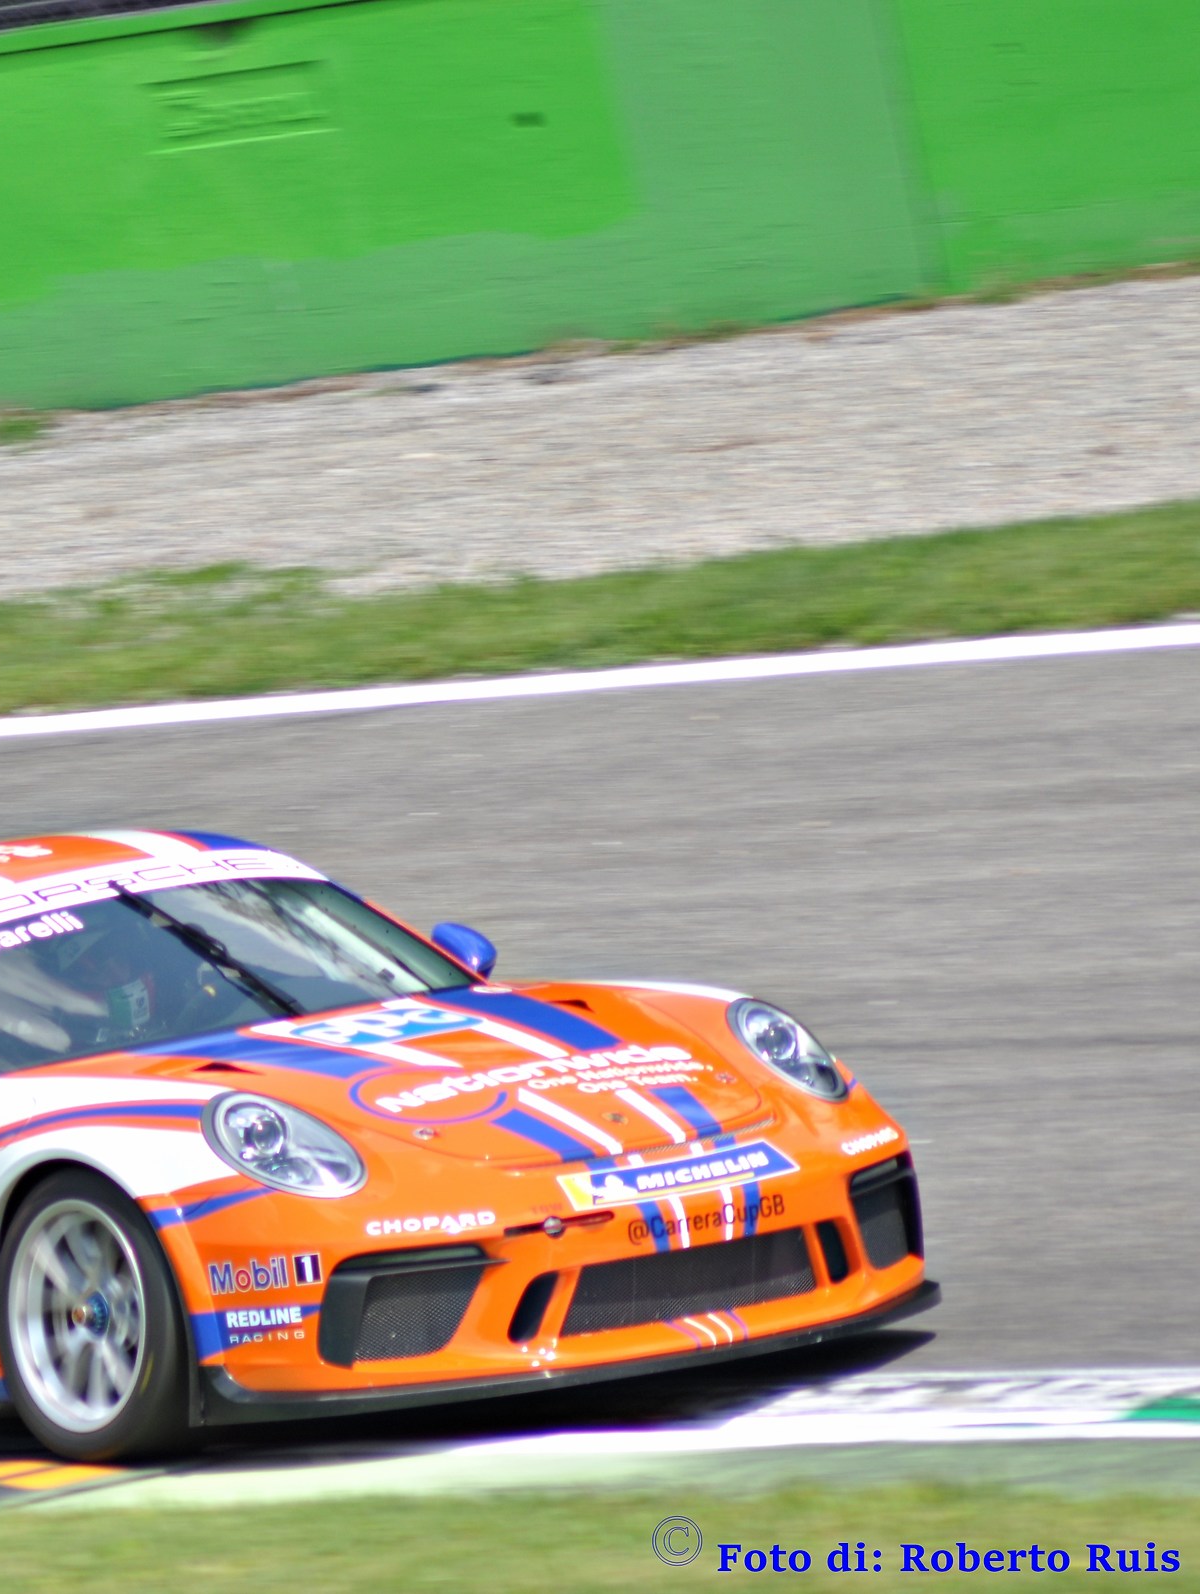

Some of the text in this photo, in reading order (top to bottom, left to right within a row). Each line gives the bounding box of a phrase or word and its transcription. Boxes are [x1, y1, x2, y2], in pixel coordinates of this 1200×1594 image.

[375, 1044, 692, 1113] Nationwide
[577, 1078, 628, 1093] One
[636, 1151, 769, 1192] MICHELIN
[365, 1210, 496, 1237] CHOPARD
[627, 1194, 785, 1246] @CarreraCupGB
[208, 1254, 317, 1295] Mobil 1
[226, 1306, 303, 1329] REDLINE
[229, 1330, 305, 1345] RACING
